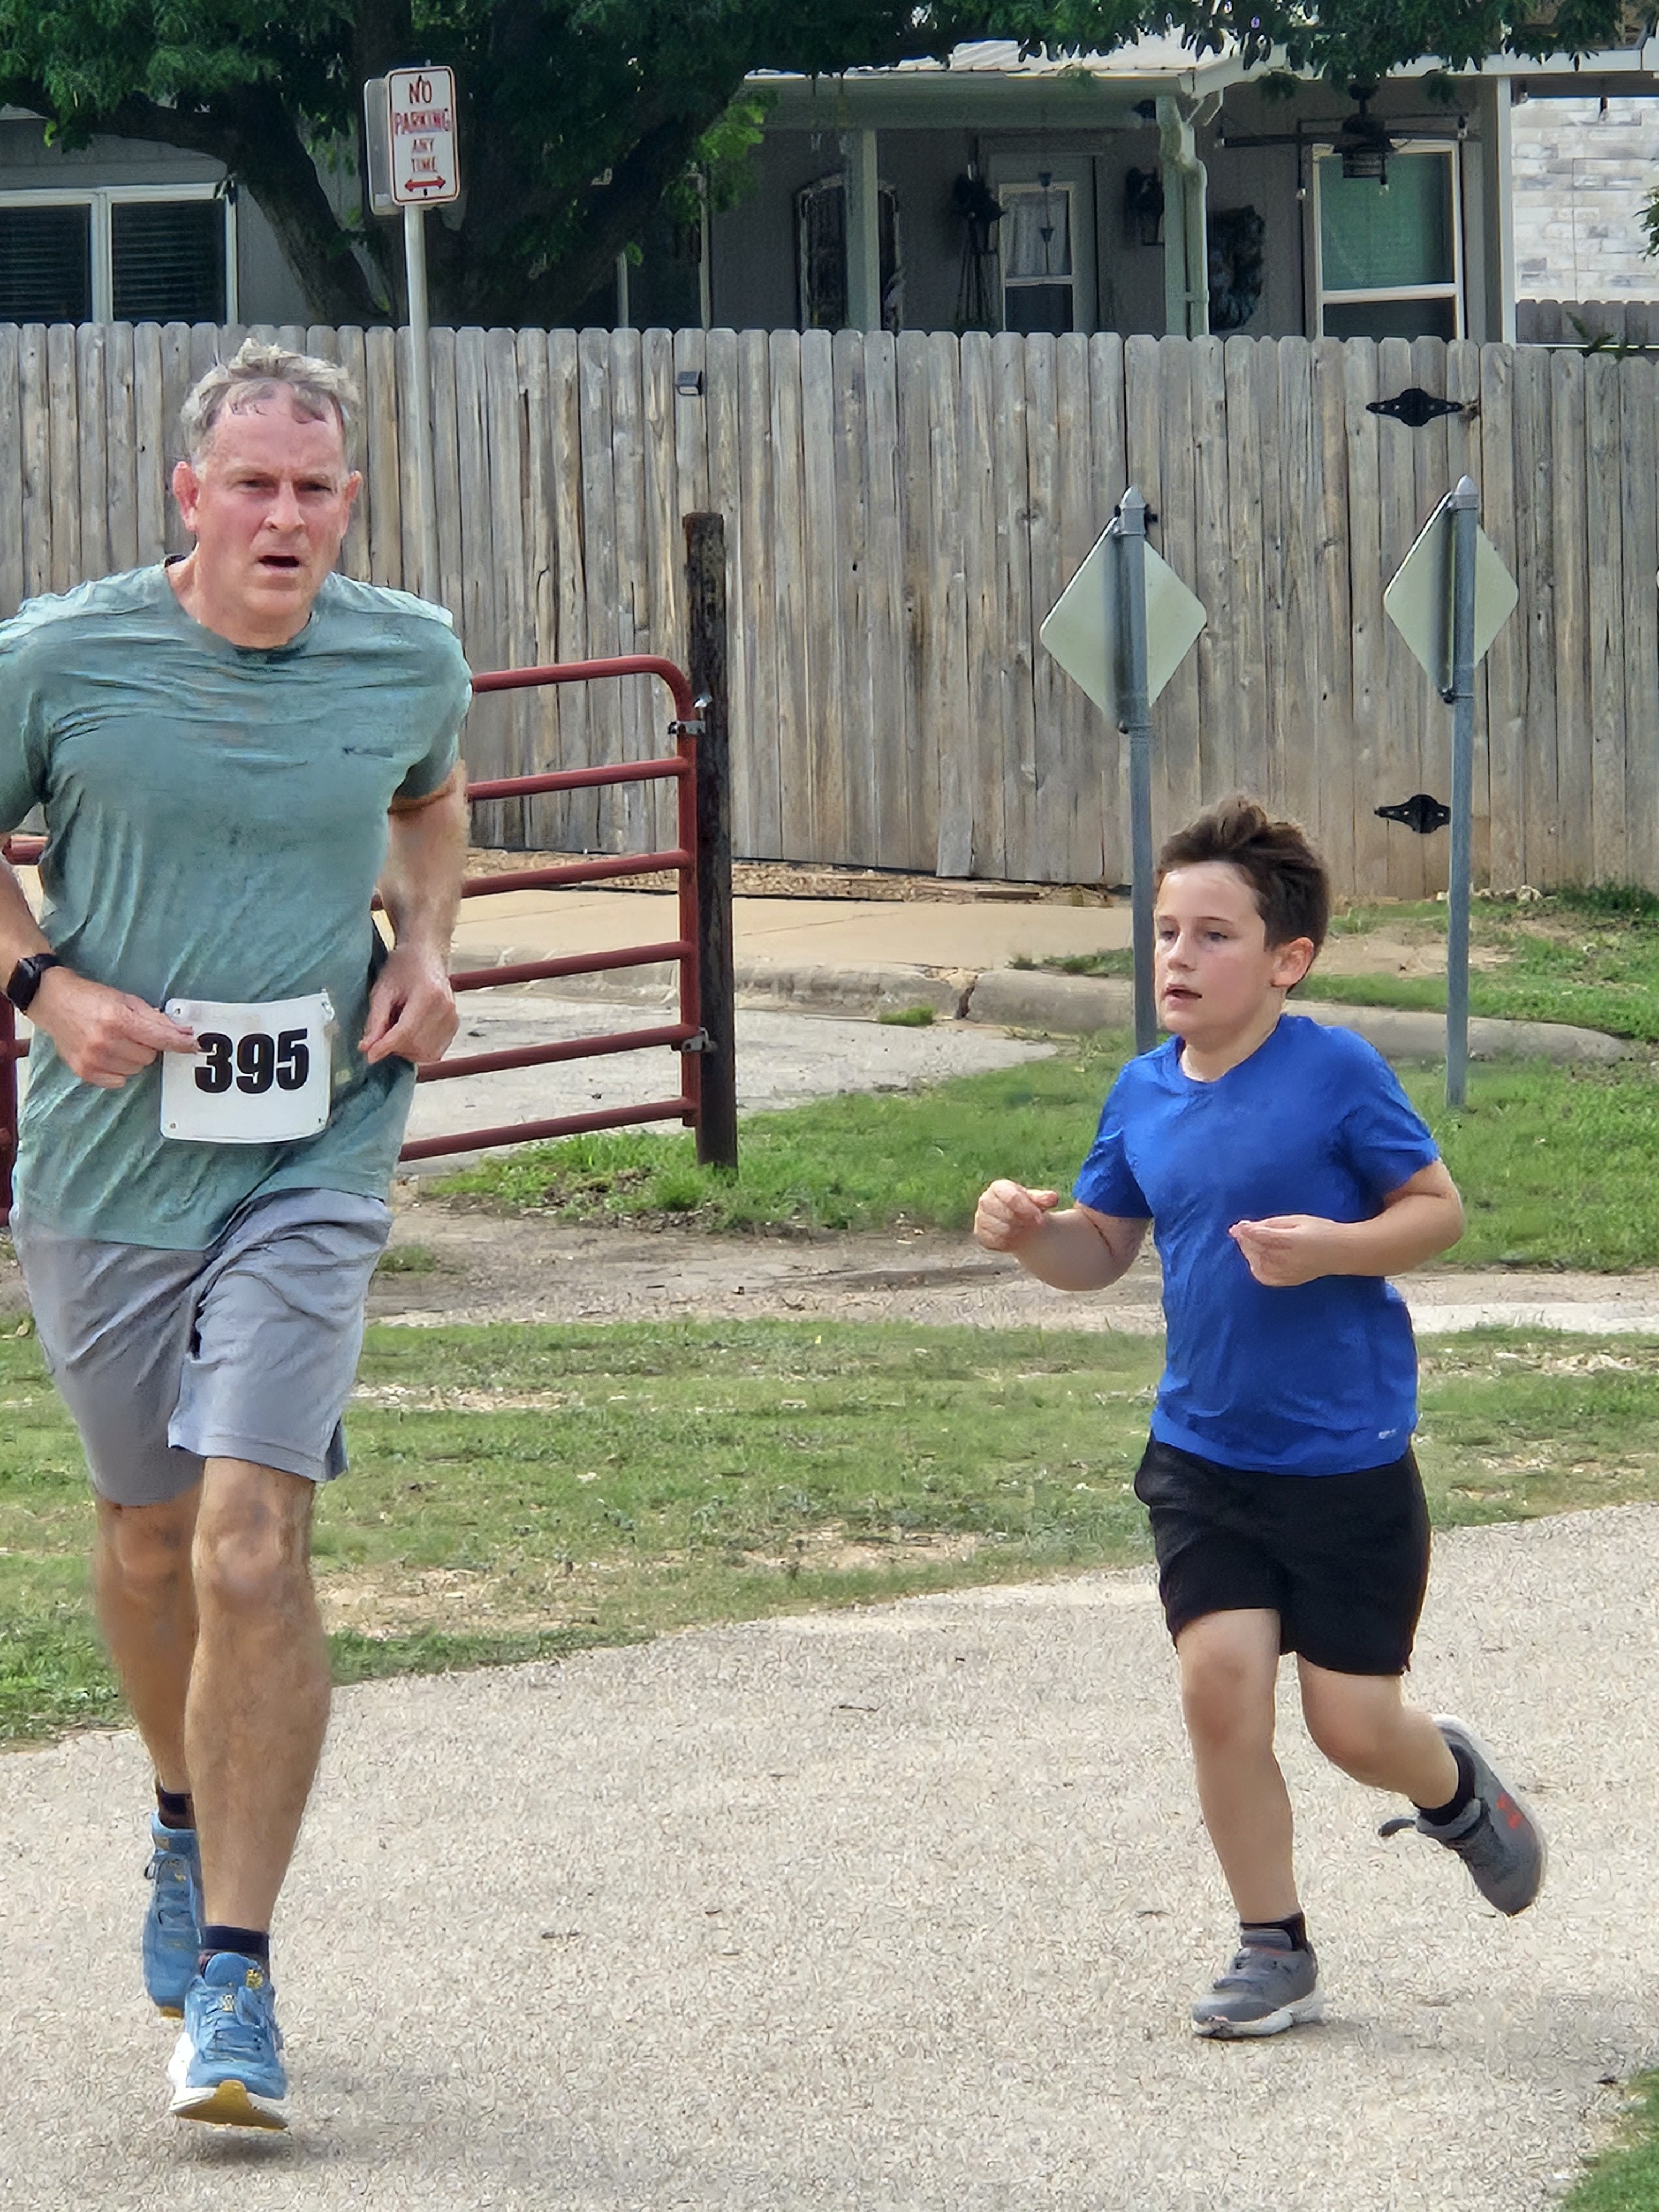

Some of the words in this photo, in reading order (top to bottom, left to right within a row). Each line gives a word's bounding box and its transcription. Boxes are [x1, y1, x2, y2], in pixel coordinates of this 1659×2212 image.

[409, 80, 432, 104] NO
[395, 109, 451, 135] PARKING
[195, 1028, 309, 1094] 395
